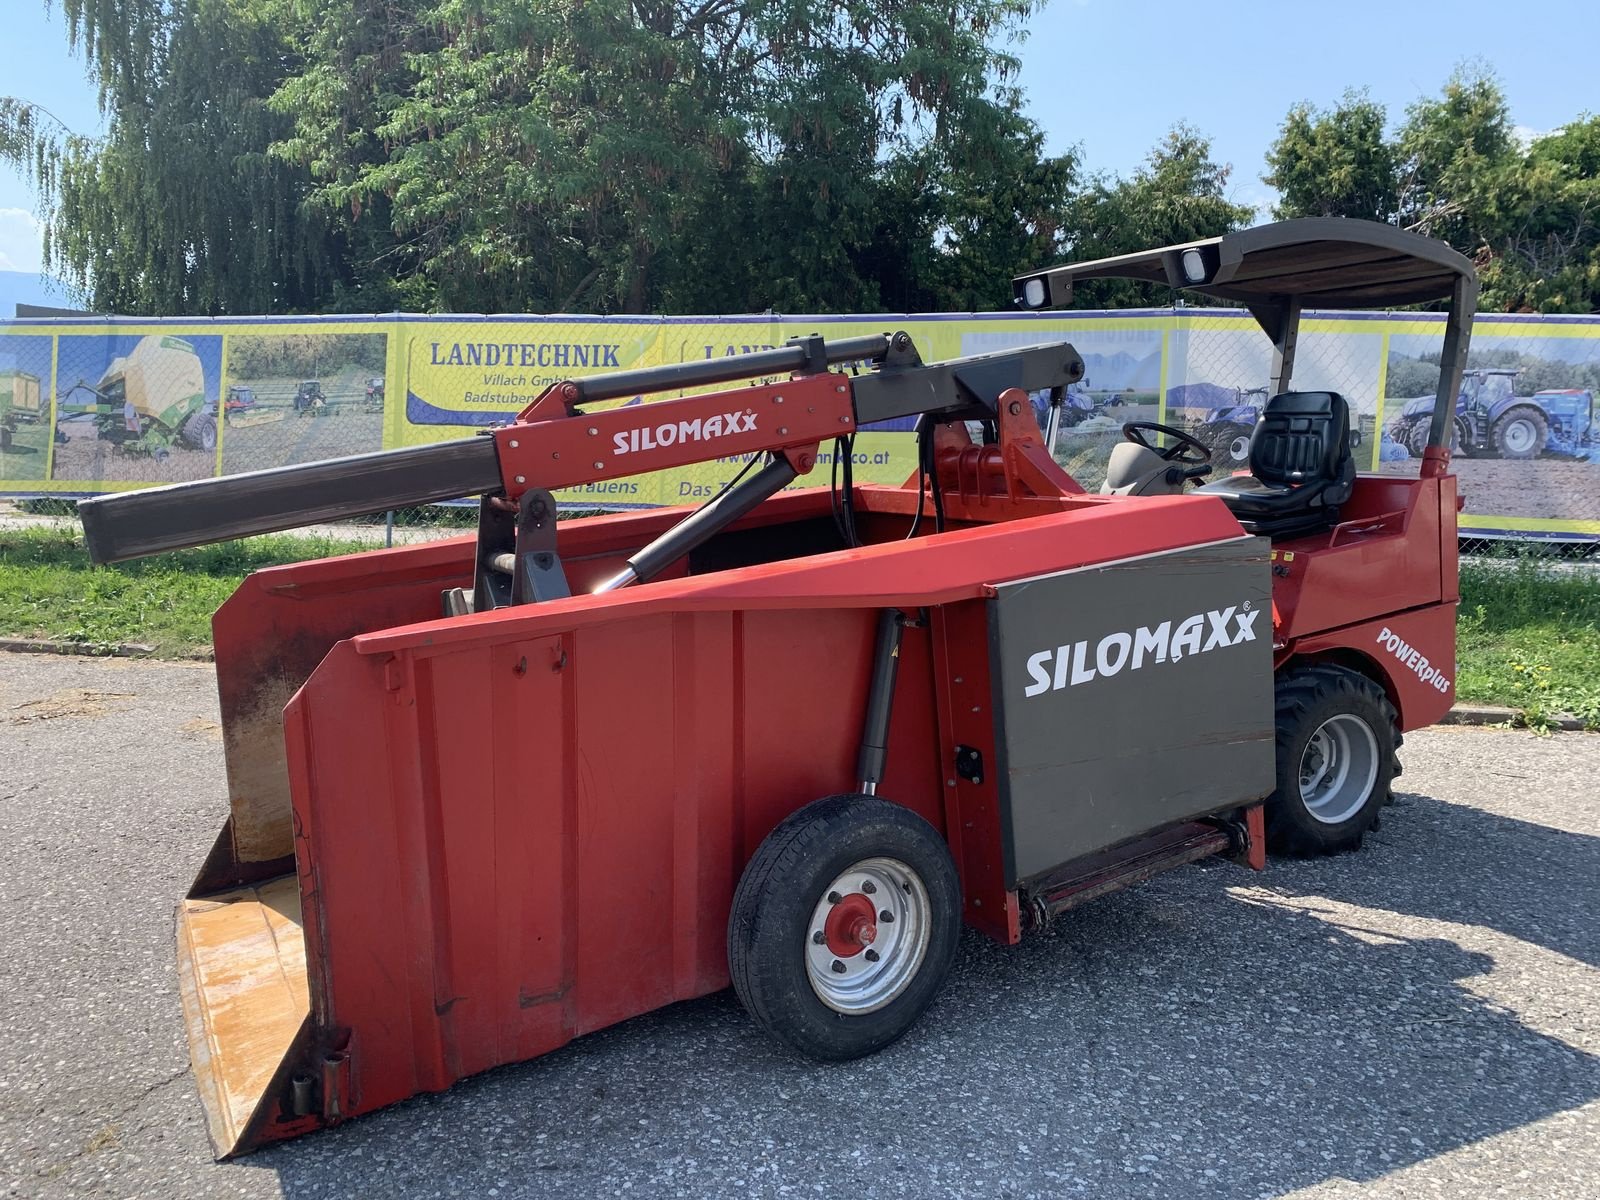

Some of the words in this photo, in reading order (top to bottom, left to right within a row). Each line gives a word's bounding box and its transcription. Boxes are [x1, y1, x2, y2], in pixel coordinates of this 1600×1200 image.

[430, 342, 620, 367] LANDTECHNIK
[484, 374, 526, 386] Villach
[531, 374, 572, 386] Gmb
[679, 481, 711, 497] Das
[1376, 626, 1451, 693] POWERplus
